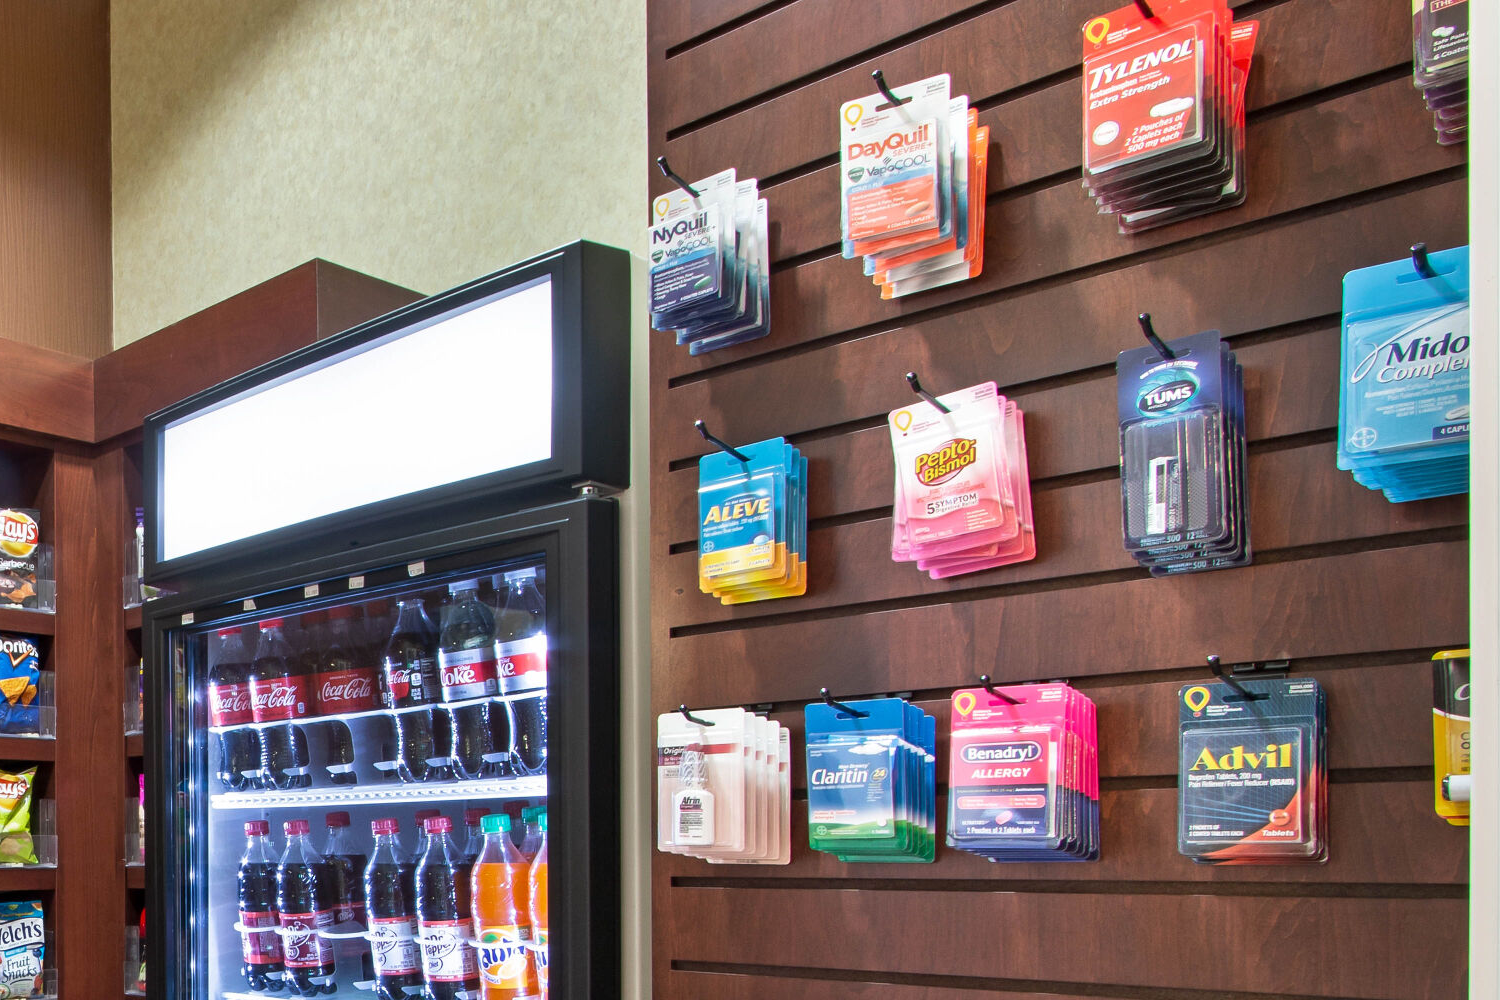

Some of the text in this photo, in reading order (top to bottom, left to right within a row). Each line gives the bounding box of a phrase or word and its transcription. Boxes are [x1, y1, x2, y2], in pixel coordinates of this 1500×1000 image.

[1088, 39, 1193, 91] TYLENOL
[1089, 75, 1171, 110] Extra Strength
[1124, 121, 1183, 146] 2 Caplets each
[1132, 111, 1186, 136] 2 Pouches of
[848, 124, 929, 161] DayQuil
[893, 143, 926, 157] SEVERE
[1127, 131, 1180, 154] 500 mg each
[866, 153, 930, 177] VapoCOOL
[653, 211, 708, 245] NyQuil
[684, 226, 711, 240] SEVERE
[665, 236, 714, 258] VapoCOOL
[1145, 386, 1191, 406] TUMS
[1440, 427, 1446, 435] 4
[915, 439, 977, 473] Pepto-
[924, 450, 976, 484] Bismol
[703, 497, 771, 525] ALEVE
[927, 493, 977, 515] 5 SYMPTOM
[1166, 532, 1195, 543] 500 12
[1192, 561, 1207, 569] 500
[441, 668, 477, 687] Coke
[497, 662, 516, 679] ke
[250, 684, 298, 709] ca-Cola
[321, 677, 372, 702] Coca-Cola
[967, 745, 1033, 762] Benadryl
[1188, 743, 1293, 771] Advil
[811, 769, 868, 785] Claritin
[971, 767, 1032, 779] ALLERGY
[681, 796, 701, 805] Afrin
[1262, 829, 1295, 837] Tablets
[1, 965, 38, 984] Snacks
[6, 955, 31, 972] Fruit
